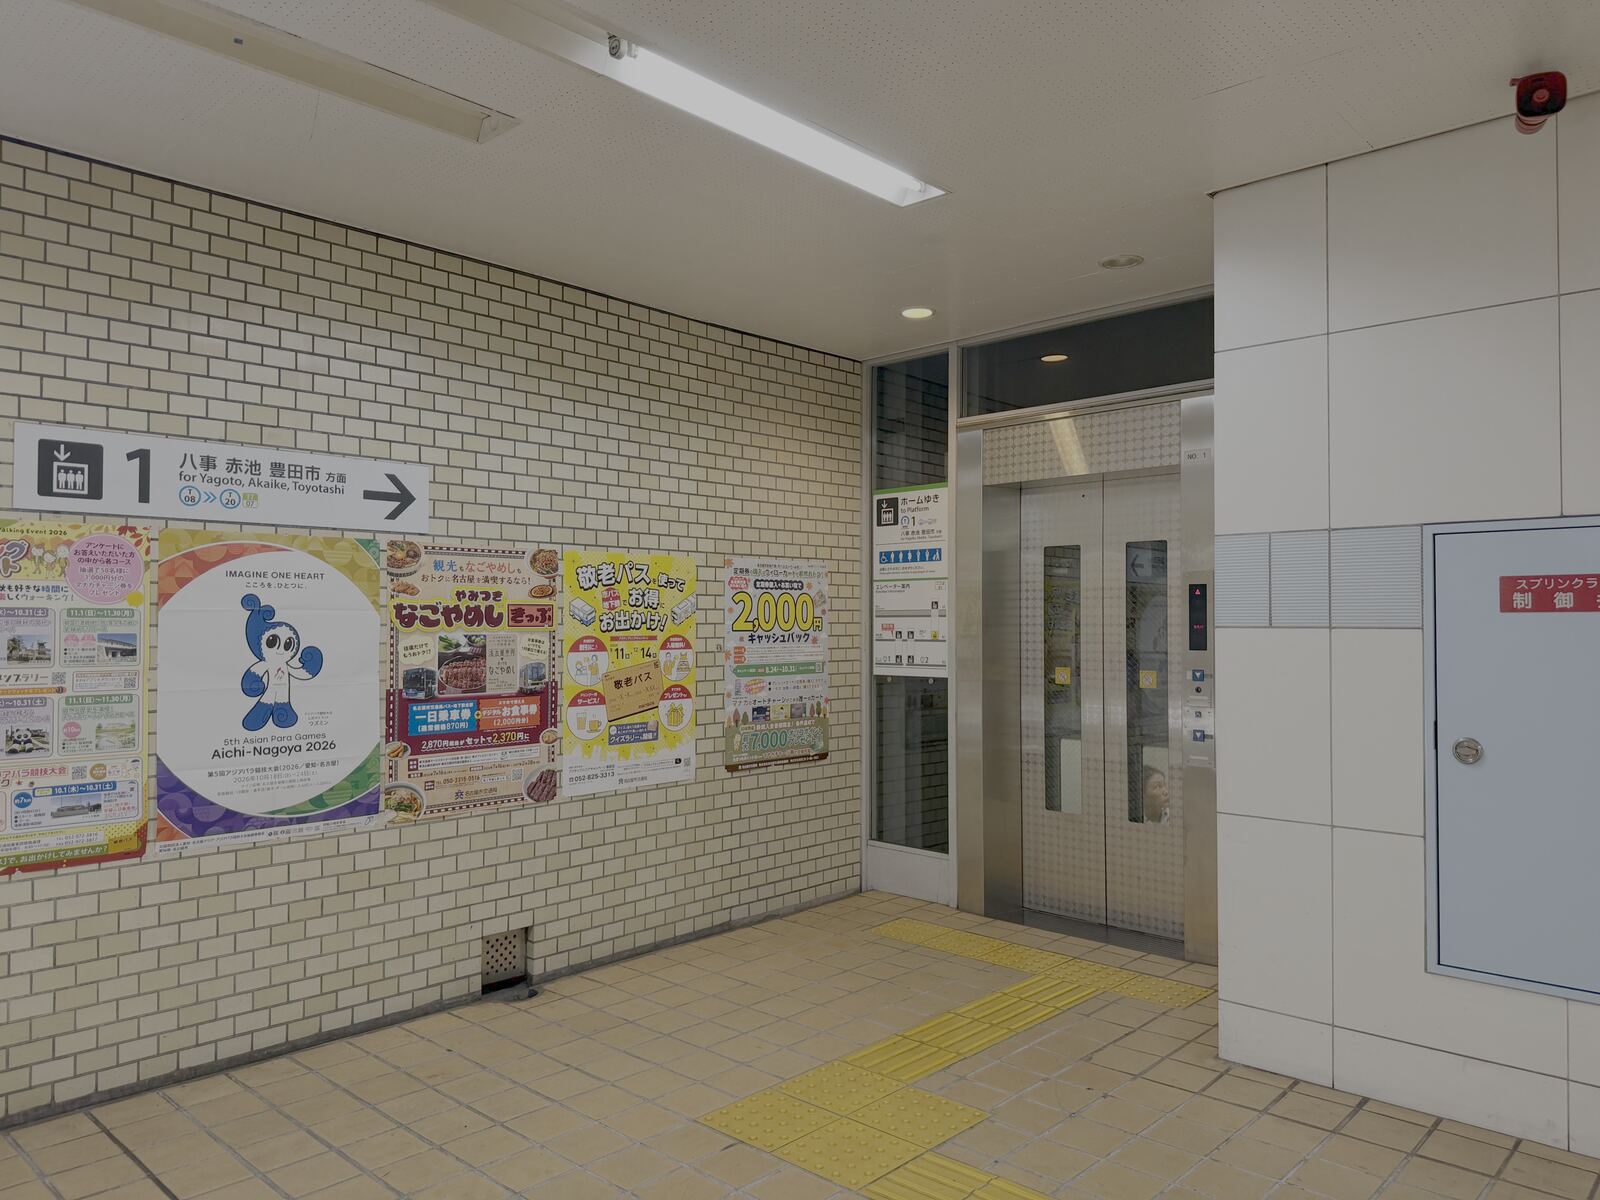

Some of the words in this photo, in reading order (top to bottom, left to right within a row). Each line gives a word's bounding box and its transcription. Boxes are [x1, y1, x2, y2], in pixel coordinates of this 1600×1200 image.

[126, 448, 150, 503] 1
[179, 452, 217, 472] 八事
[225, 458, 261, 476] 赤池
[269, 462, 321, 482] 豊田市
[325, 472, 347, 484] 方面
[178, 471, 198, 482] for
[200, 473, 245, 488] Yagoto,
[248, 477, 290, 492] Akaike,
[292, 481, 345, 496] Toyotashi
[184, 495, 196, 503] 08
[224, 498, 236, 506] 20
[900, 494, 940, 506] ホームゆき
[911, 516, 916, 526] 1
[73, 549, 135, 559] お答えいただいた方
[77, 558, 132, 566] の中から各コース
[433, 559, 522, 574] 観光もなごやめしも
[225, 569, 269, 579] IMAGINE
[271, 571, 291, 580] ONE
[293, 572, 325, 581] HEART
[421, 574, 531, 586] おトクに名古屋を満喫するなら!
[455, 589, 503, 602] やみつき
[393, 601, 504, 628] なごやめし
[510, 606, 552, 624] きっぷ
[731, 590, 823, 633] 2,000円
[600, 610, 668, 633] お出かけ!
[748, 632, 810, 644] キャッシュバック
[613, 671, 653, 690] 敬老パス
[415, 708, 471, 723] 一日乗車券
[224, 737, 240, 747] 5th
[243, 736, 269, 745] Asian
[270, 734, 292, 743] Para
[294, 731, 327, 741] Games
[211, 743, 302, 760] Aichi-Nagoya
[305, 740, 337, 752] 2026
